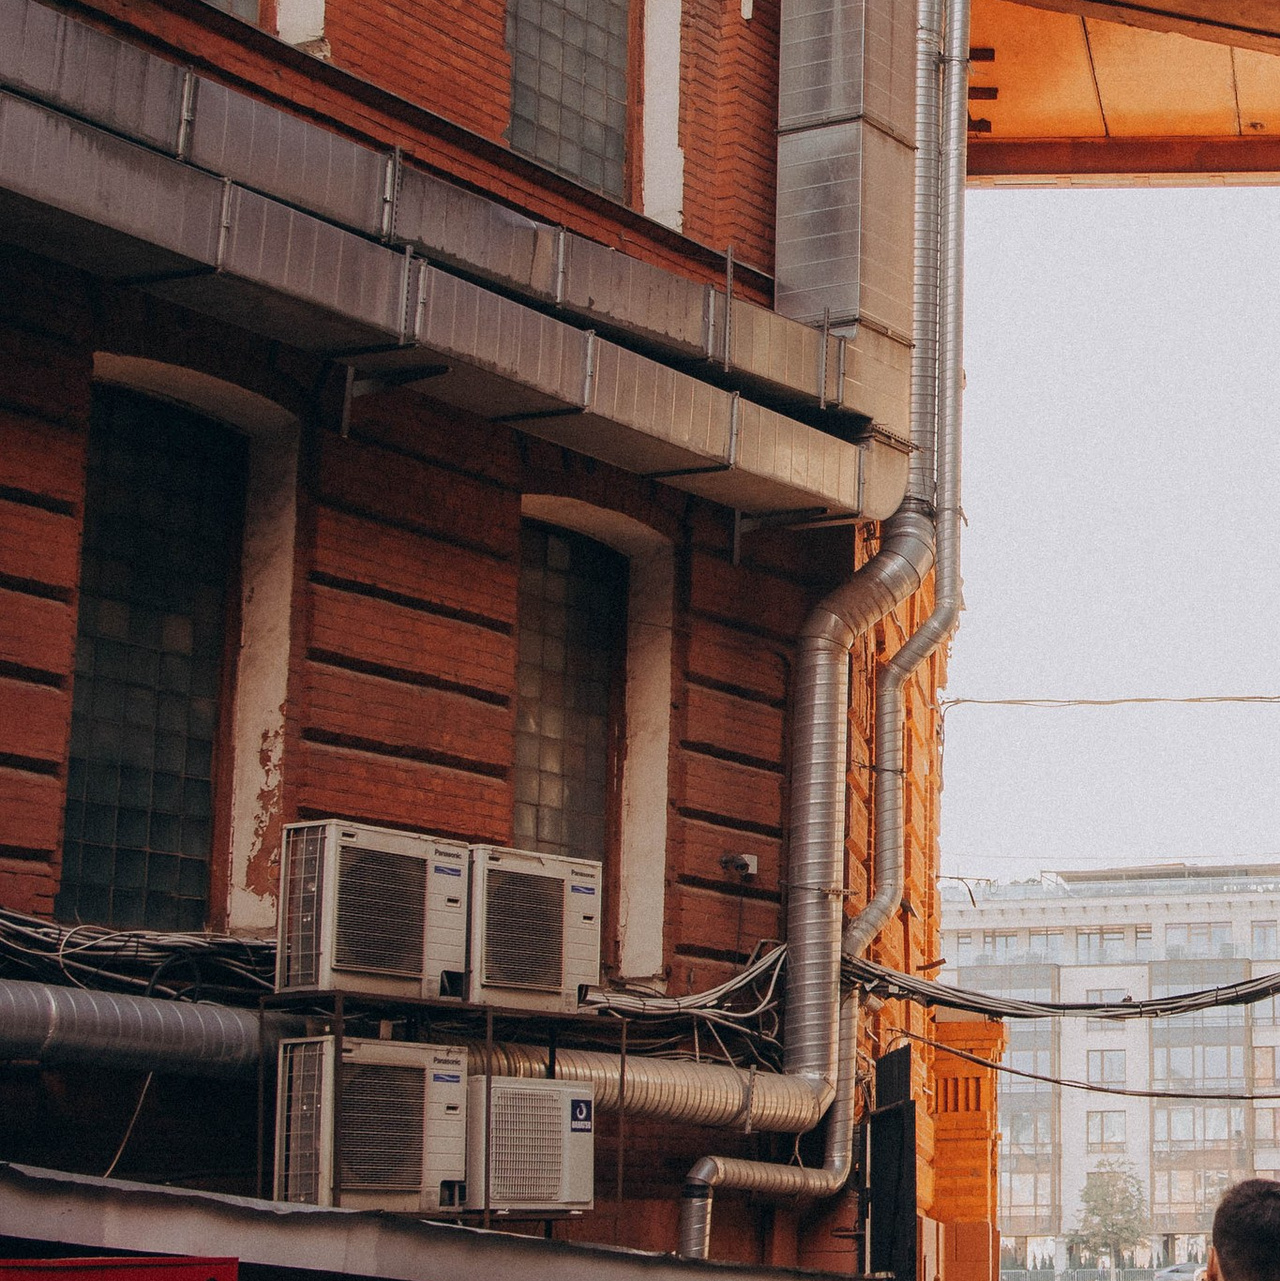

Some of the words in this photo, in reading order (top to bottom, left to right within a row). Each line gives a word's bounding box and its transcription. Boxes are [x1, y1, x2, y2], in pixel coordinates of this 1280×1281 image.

[434, 848, 462, 859] Panasonic
[571, 869, 596, 879] Panasonic
[433, 1056, 461, 1066] Panasonic
